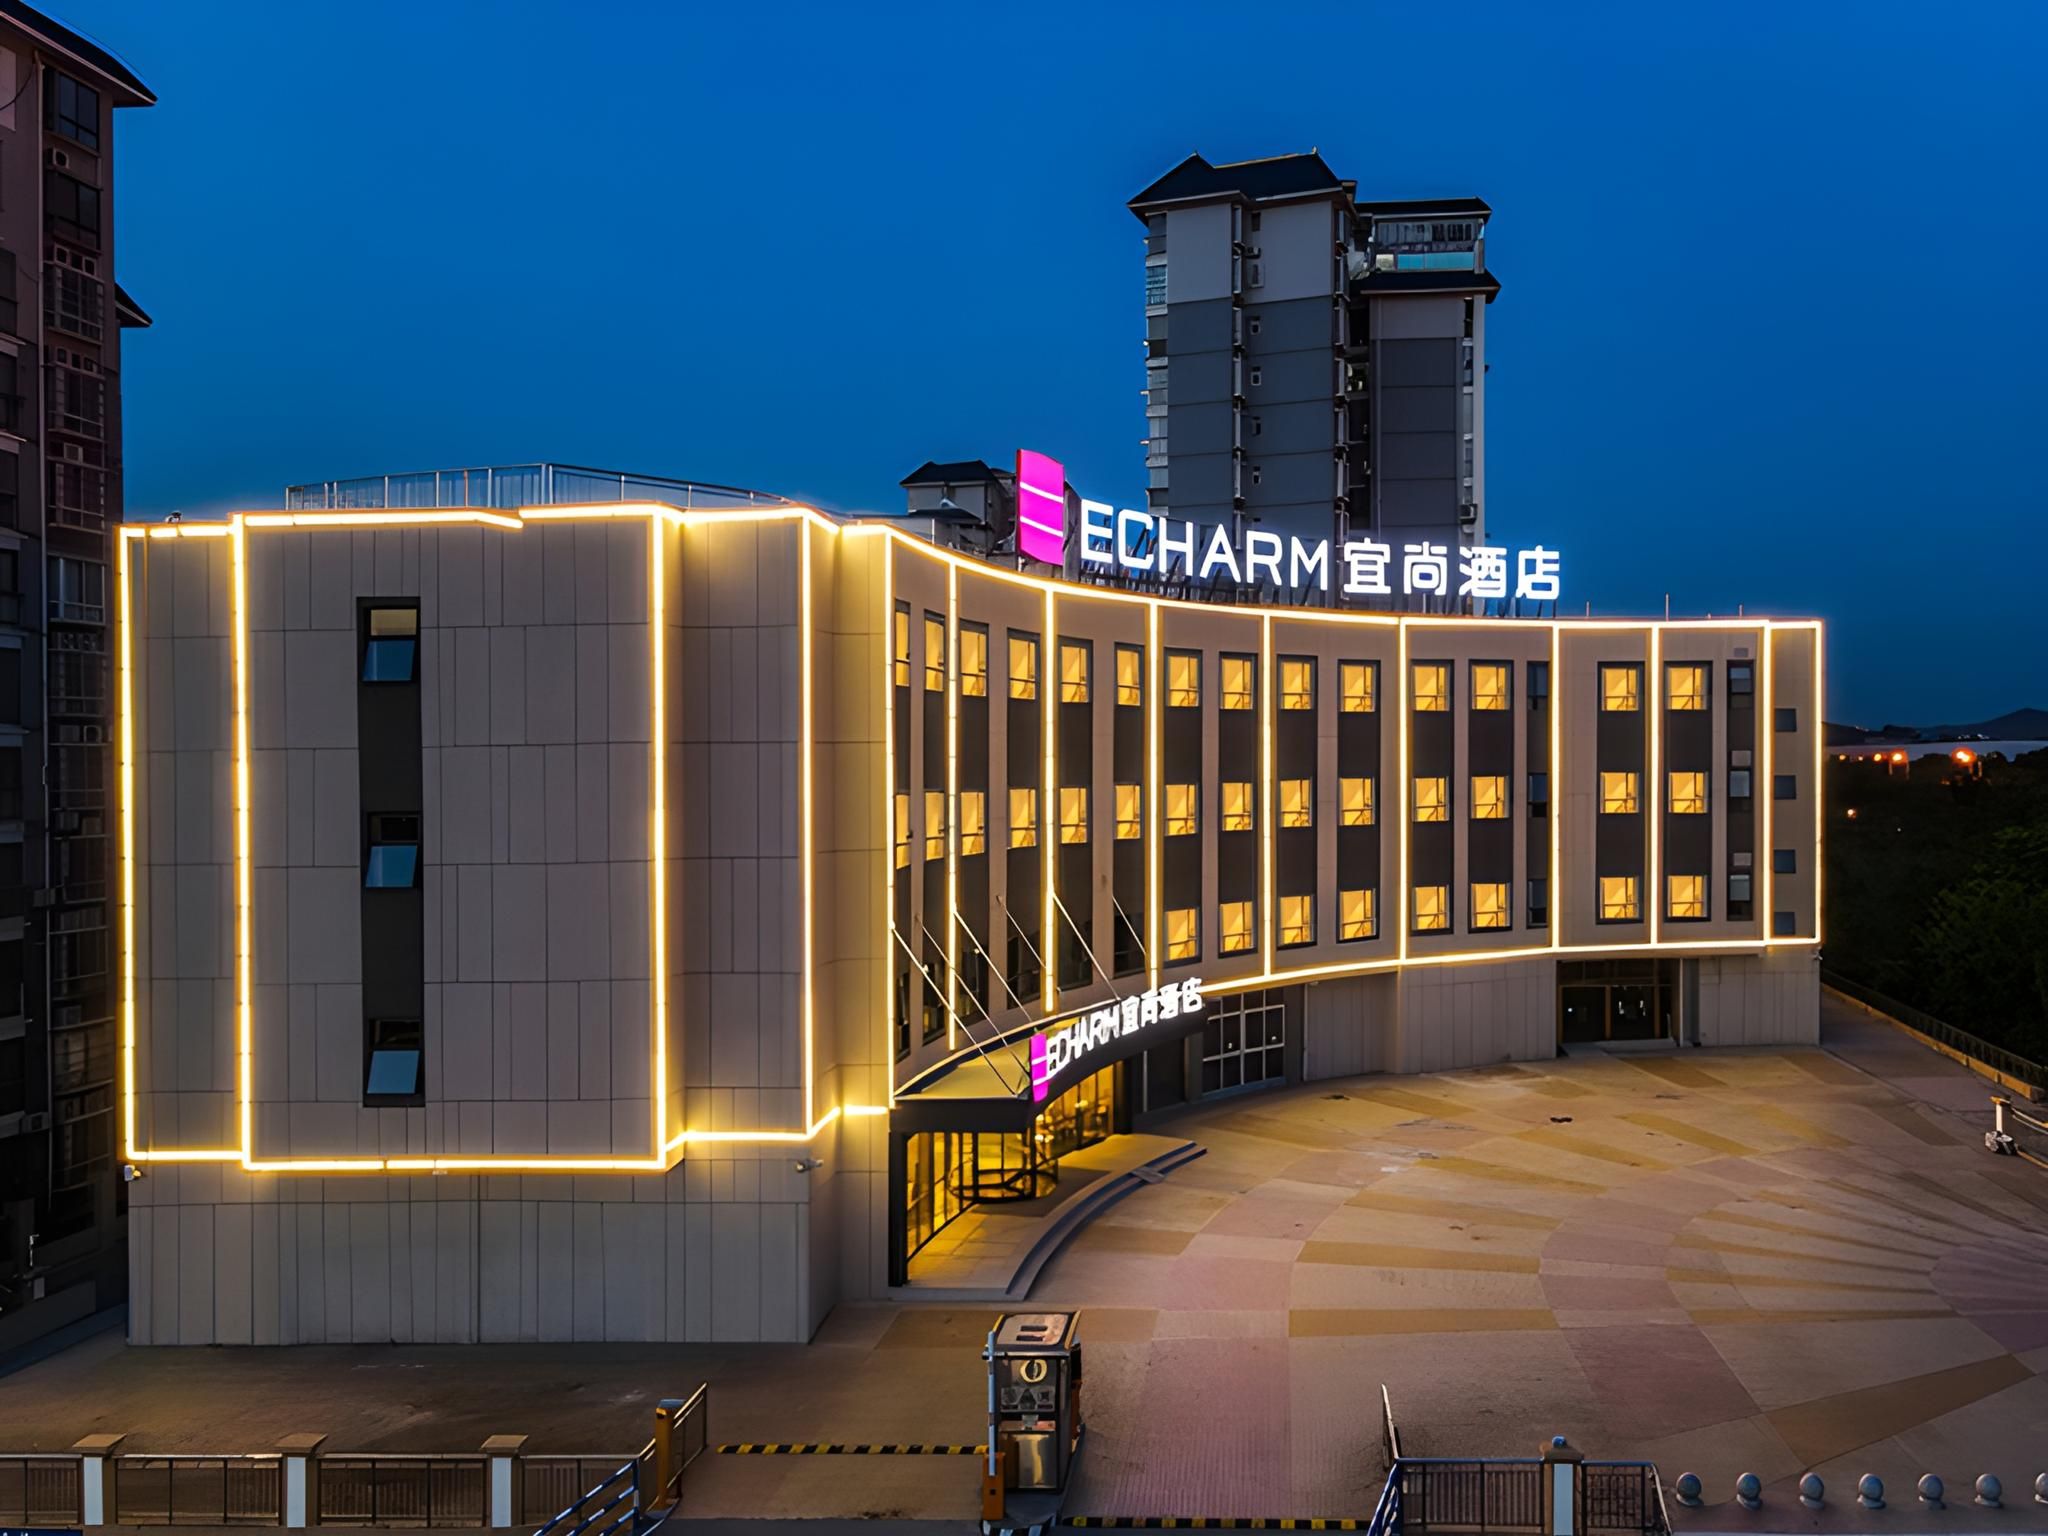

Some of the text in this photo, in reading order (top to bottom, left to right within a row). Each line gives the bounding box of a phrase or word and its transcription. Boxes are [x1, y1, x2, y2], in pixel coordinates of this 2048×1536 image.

[1081, 500, 1560, 600] ECHARM 宜尚酒店
[1047, 1004, 1120, 1078] ECHARM
